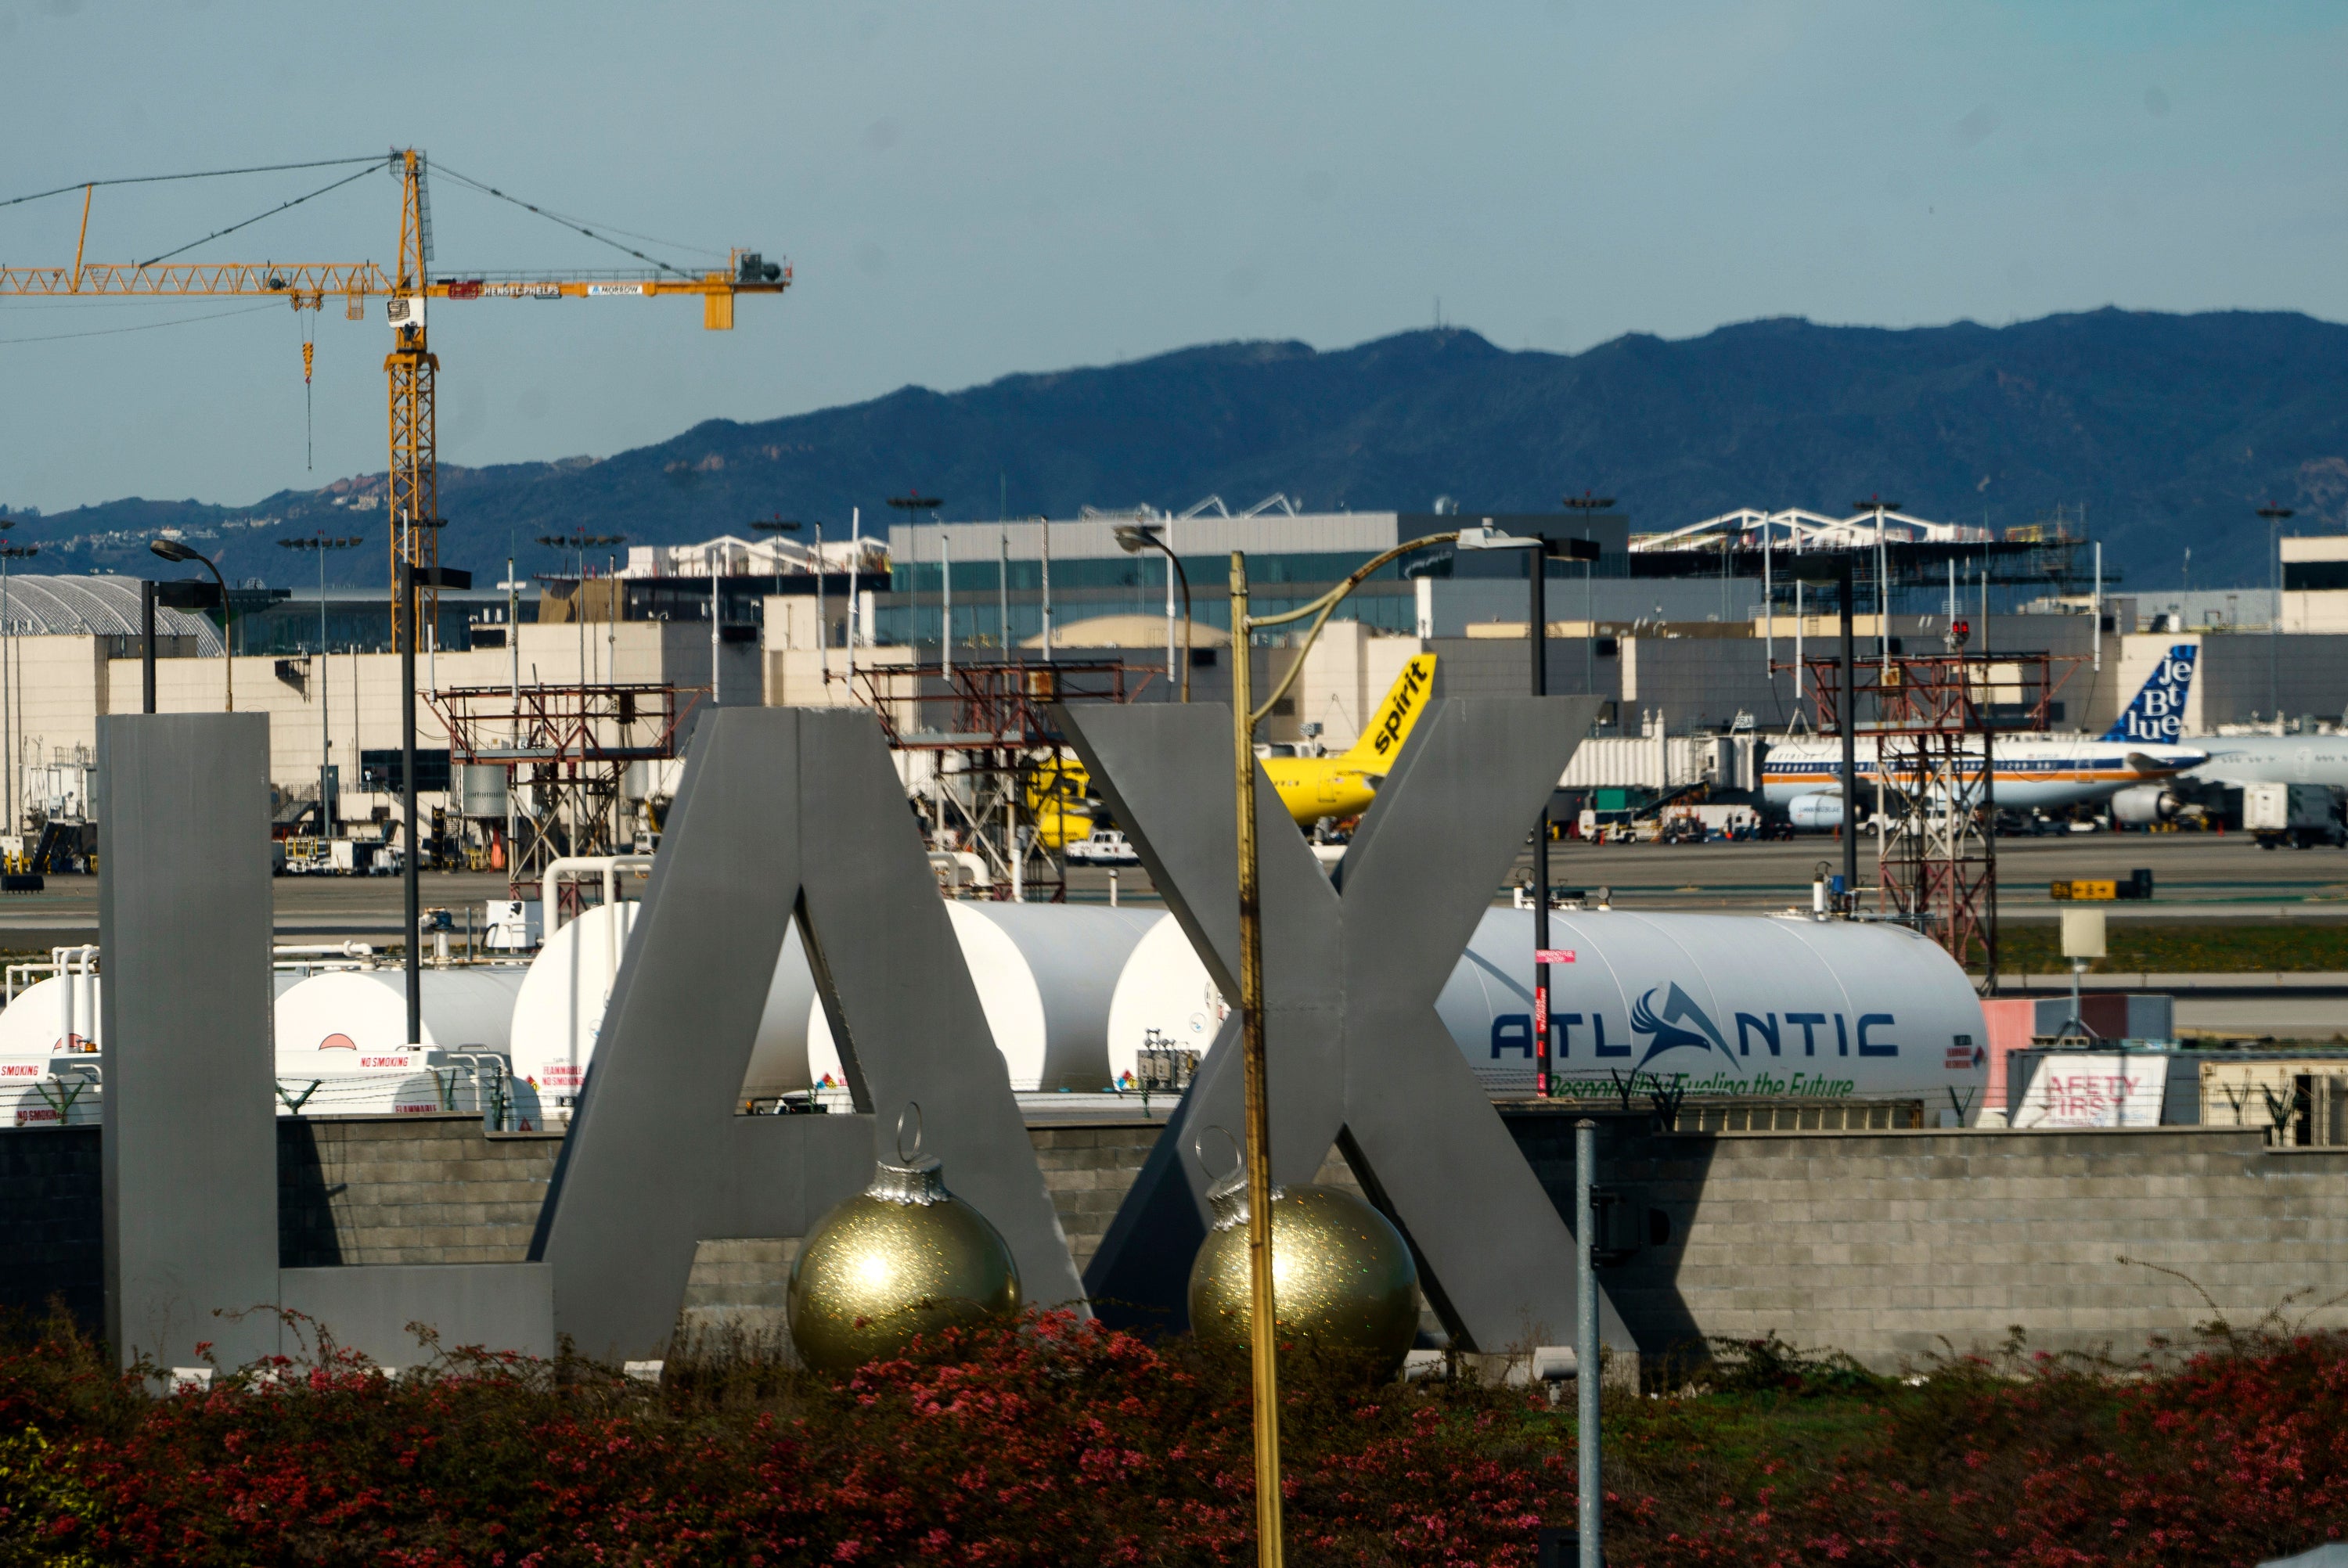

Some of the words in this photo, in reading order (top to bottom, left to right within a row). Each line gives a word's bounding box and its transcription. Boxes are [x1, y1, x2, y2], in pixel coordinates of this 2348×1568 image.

[484, 287, 520, 296] HENSEL
[523, 286, 559, 295] PHELPS
[1374, 660, 1428, 756] spirit
[98, 692, 1640, 1365] LAX
[361, 1058, 371, 1067] NO
[373, 1057, 409, 1066] SMOKING
[1, 1066, 39, 1076] SMOKING
[543, 1066, 582, 1075] FLAMMABLE
[542, 1077, 552, 1086] NO
[1754, 1072, 1785, 1096] the
[2049, 1076, 2142, 1095] AFETY
[17, 1110, 28, 1121] NO
